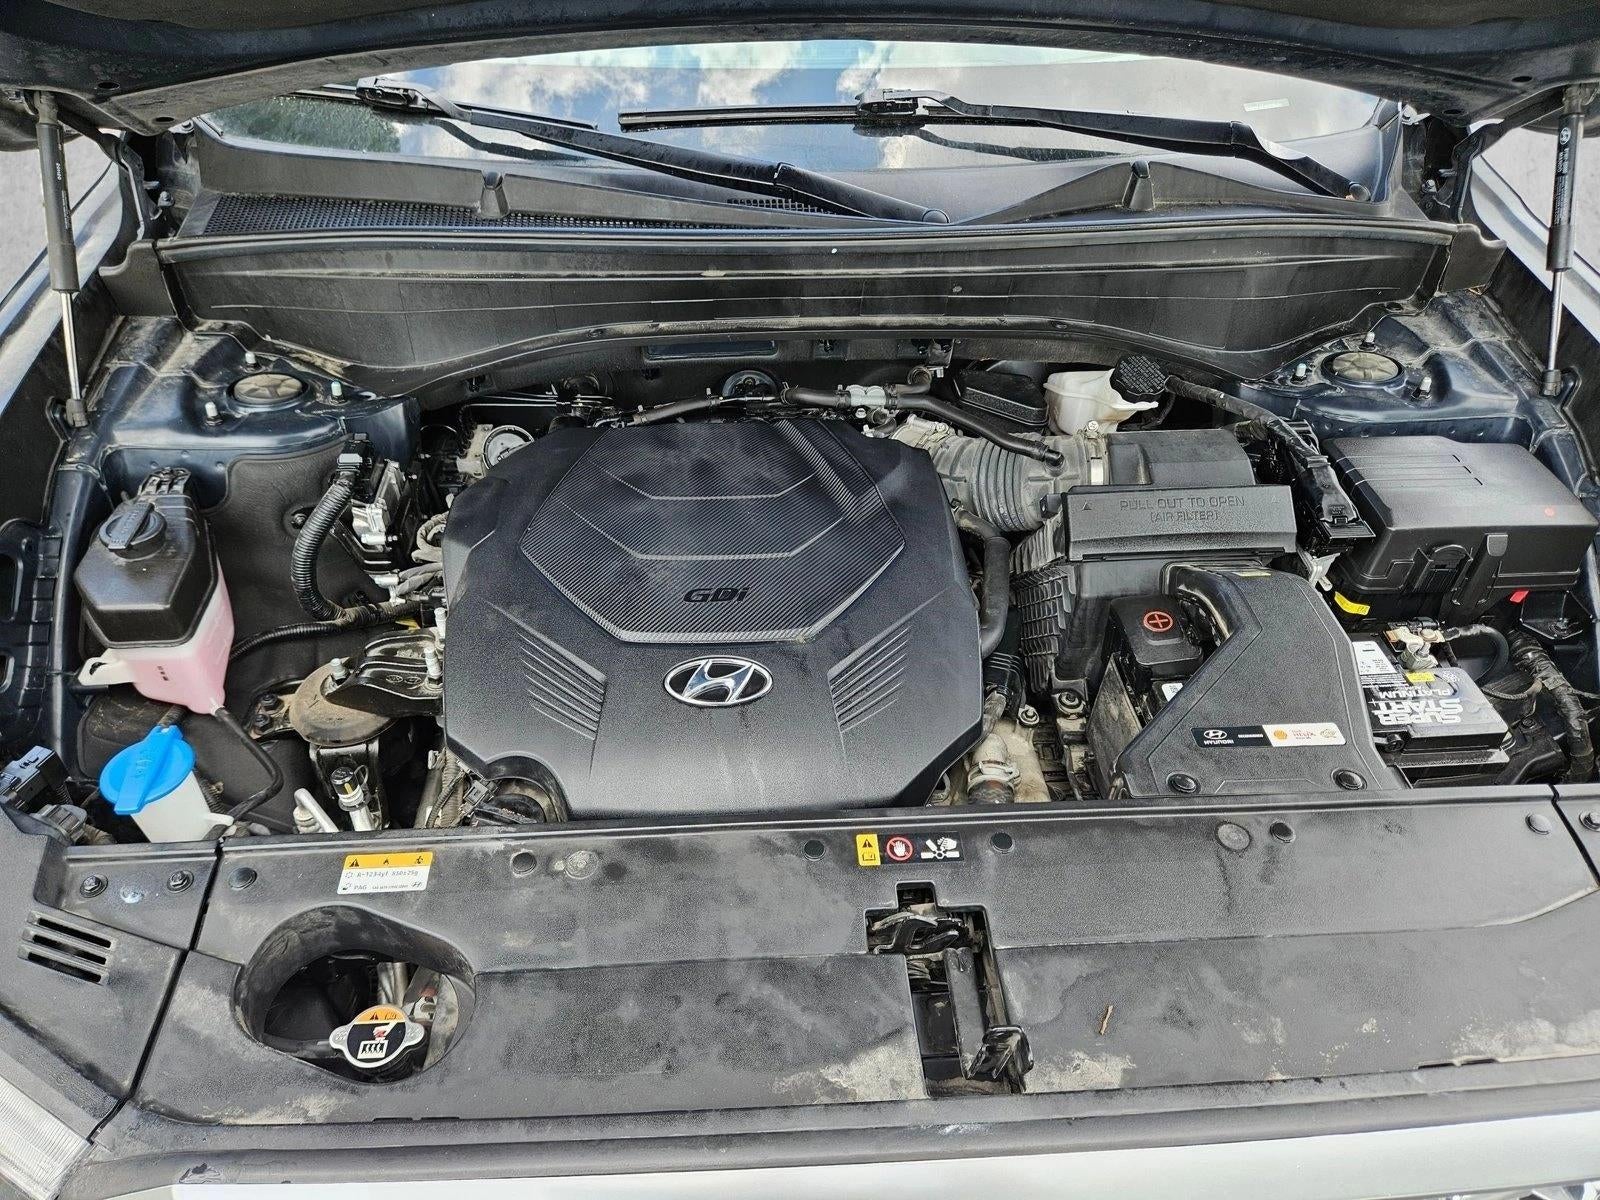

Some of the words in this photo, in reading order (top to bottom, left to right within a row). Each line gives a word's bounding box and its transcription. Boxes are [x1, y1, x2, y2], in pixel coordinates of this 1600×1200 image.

[1120, 499, 1154, 511] PULL
[1157, 498, 1184, 509] OUT
[1187, 497, 1206, 508] TO
[1209, 495, 1245, 507] OPEN
[682, 587, 750, 603] GDi
[1380, 688, 1451, 699] PLATINUM
[1372, 698, 1464, 716] START
[1378, 712, 1462, 726] SUPER
